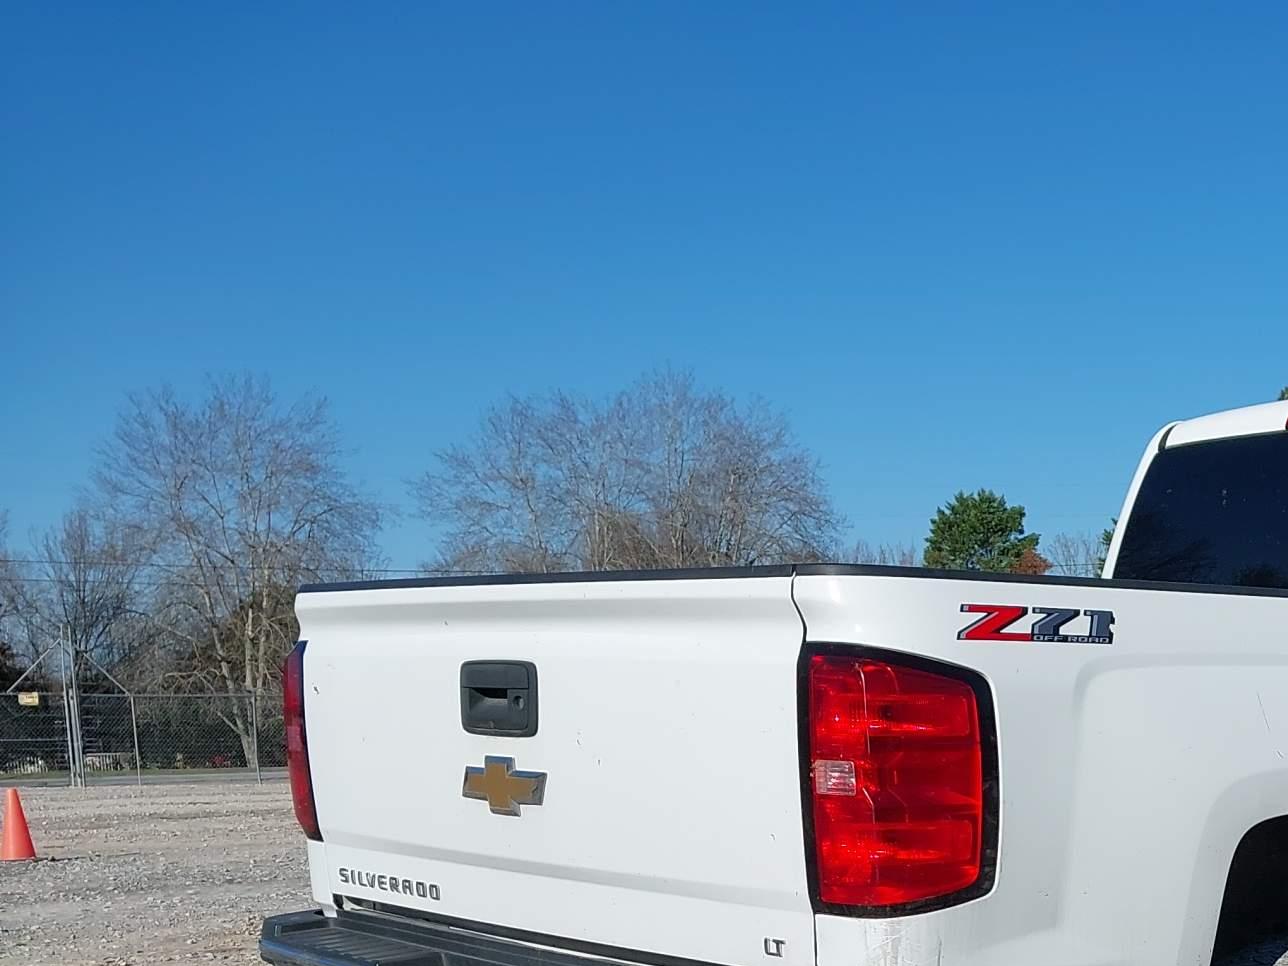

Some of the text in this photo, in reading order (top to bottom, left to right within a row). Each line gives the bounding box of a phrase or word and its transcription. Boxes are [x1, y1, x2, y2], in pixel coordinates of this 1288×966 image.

[957, 604, 1115, 642] Z71
[339, 867, 441, 901] SILVERADO
[763, 937, 786, 958] LT
